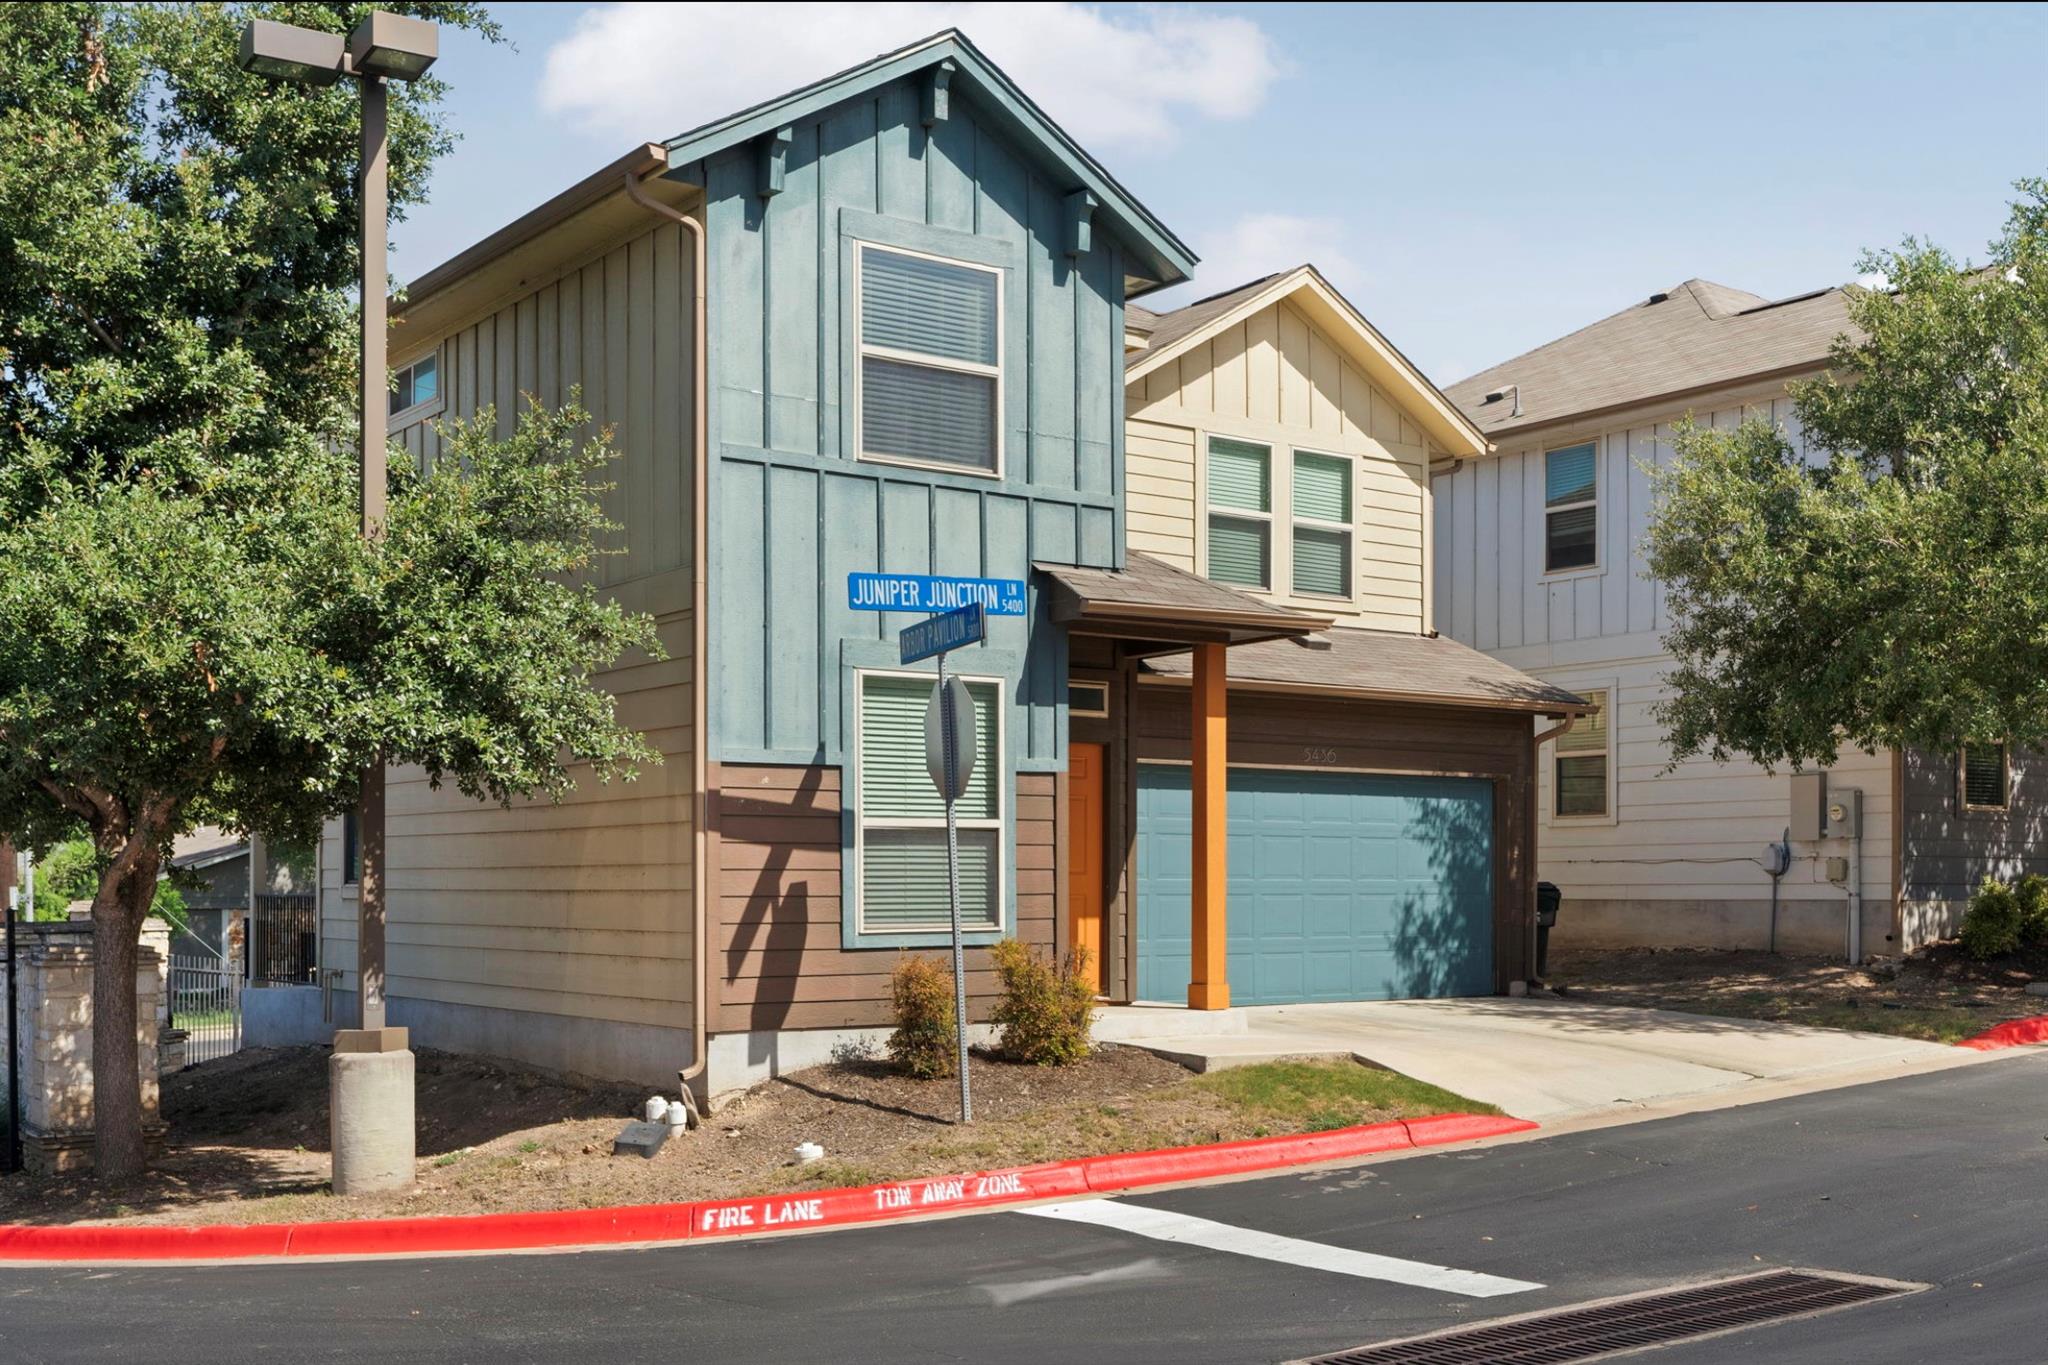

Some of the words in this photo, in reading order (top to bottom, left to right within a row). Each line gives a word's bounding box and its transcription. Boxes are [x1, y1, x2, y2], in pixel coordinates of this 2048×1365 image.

[853, 579, 920, 607] JUNIPER
[926, 581, 998, 610] JUNCTION
[1006, 583, 1017, 597] LN
[1002, 598, 1023, 613] 5400
[927, 612, 966, 650] PAVILION
[702, 1205, 754, 1231] FIRE
[764, 1199, 824, 1225] LANE
[874, 1188, 911, 1210] TOW
[921, 1179, 965, 1204] AWAY
[977, 1173, 1025, 1197] ZONE
